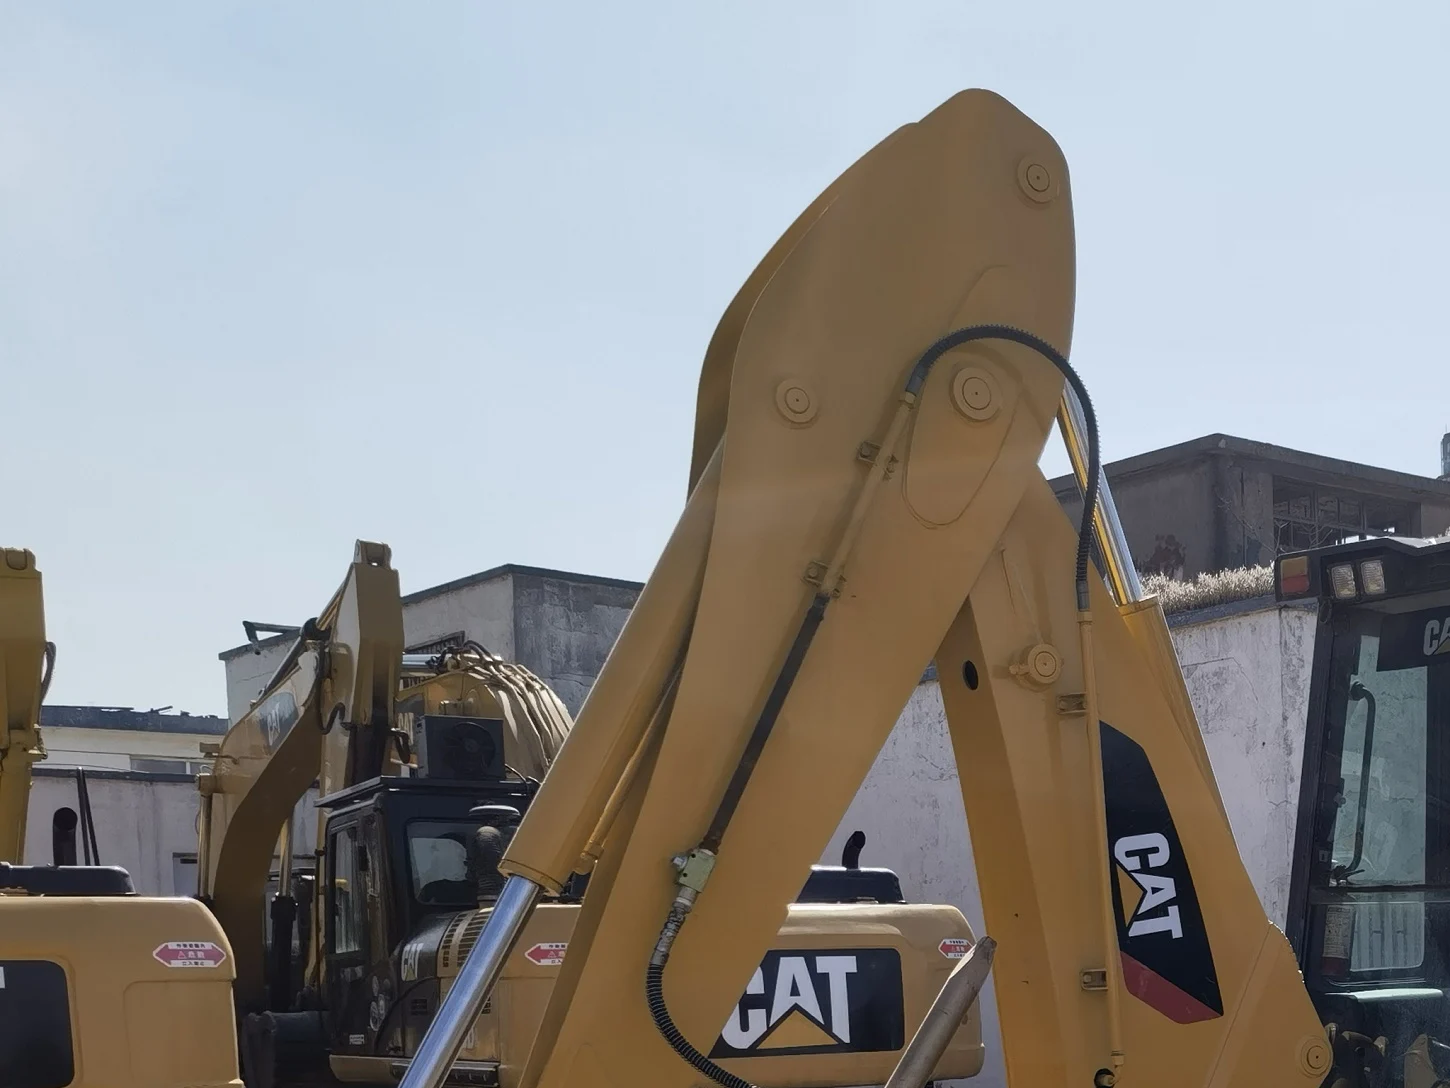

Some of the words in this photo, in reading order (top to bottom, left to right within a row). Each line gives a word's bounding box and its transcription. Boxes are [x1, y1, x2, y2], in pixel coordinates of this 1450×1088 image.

[1114, 832, 1183, 939] CAT
[401, 942, 424, 982] CAT
[721, 956, 858, 1050] CAT
